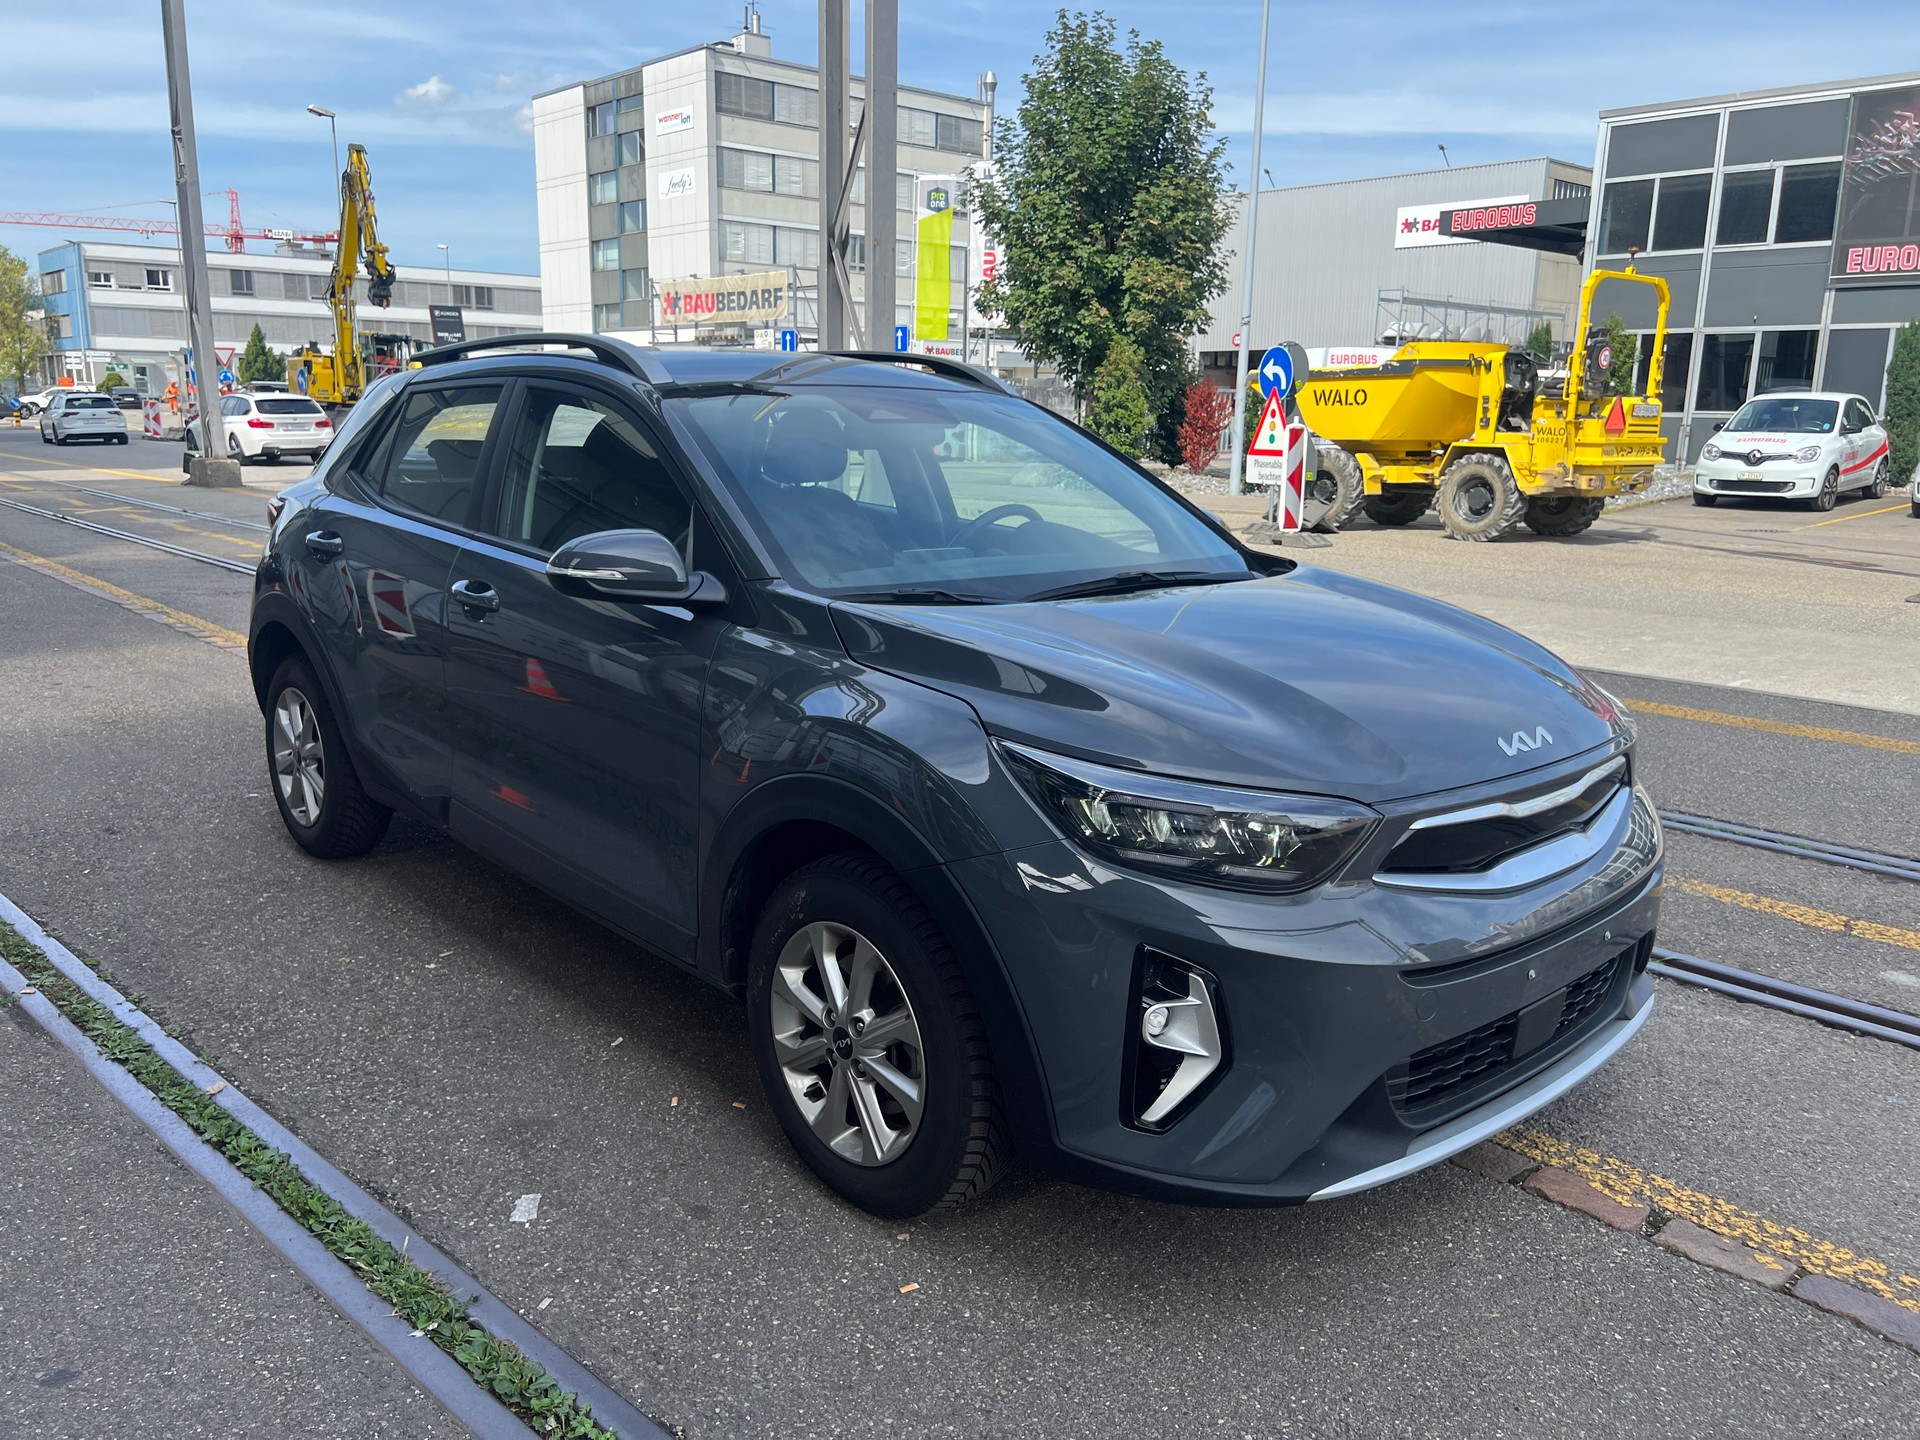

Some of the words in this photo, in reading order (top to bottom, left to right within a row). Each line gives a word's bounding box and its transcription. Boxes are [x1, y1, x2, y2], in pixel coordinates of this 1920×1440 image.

[930, 200, 946, 208] one
[1451, 204, 1537, 232] EUROBUS
[1846, 244, 1920, 273] EURO
[683, 287, 783, 314] BAUBEDARF
[936, 347, 980, 356] BAUBEDRF
[1330, 354, 1378, 365] EUROBUS
[1313, 388, 1368, 406] WALO
[1536, 426, 1566, 437] WALO
[1254, 459, 1282, 469] Phasenabla
